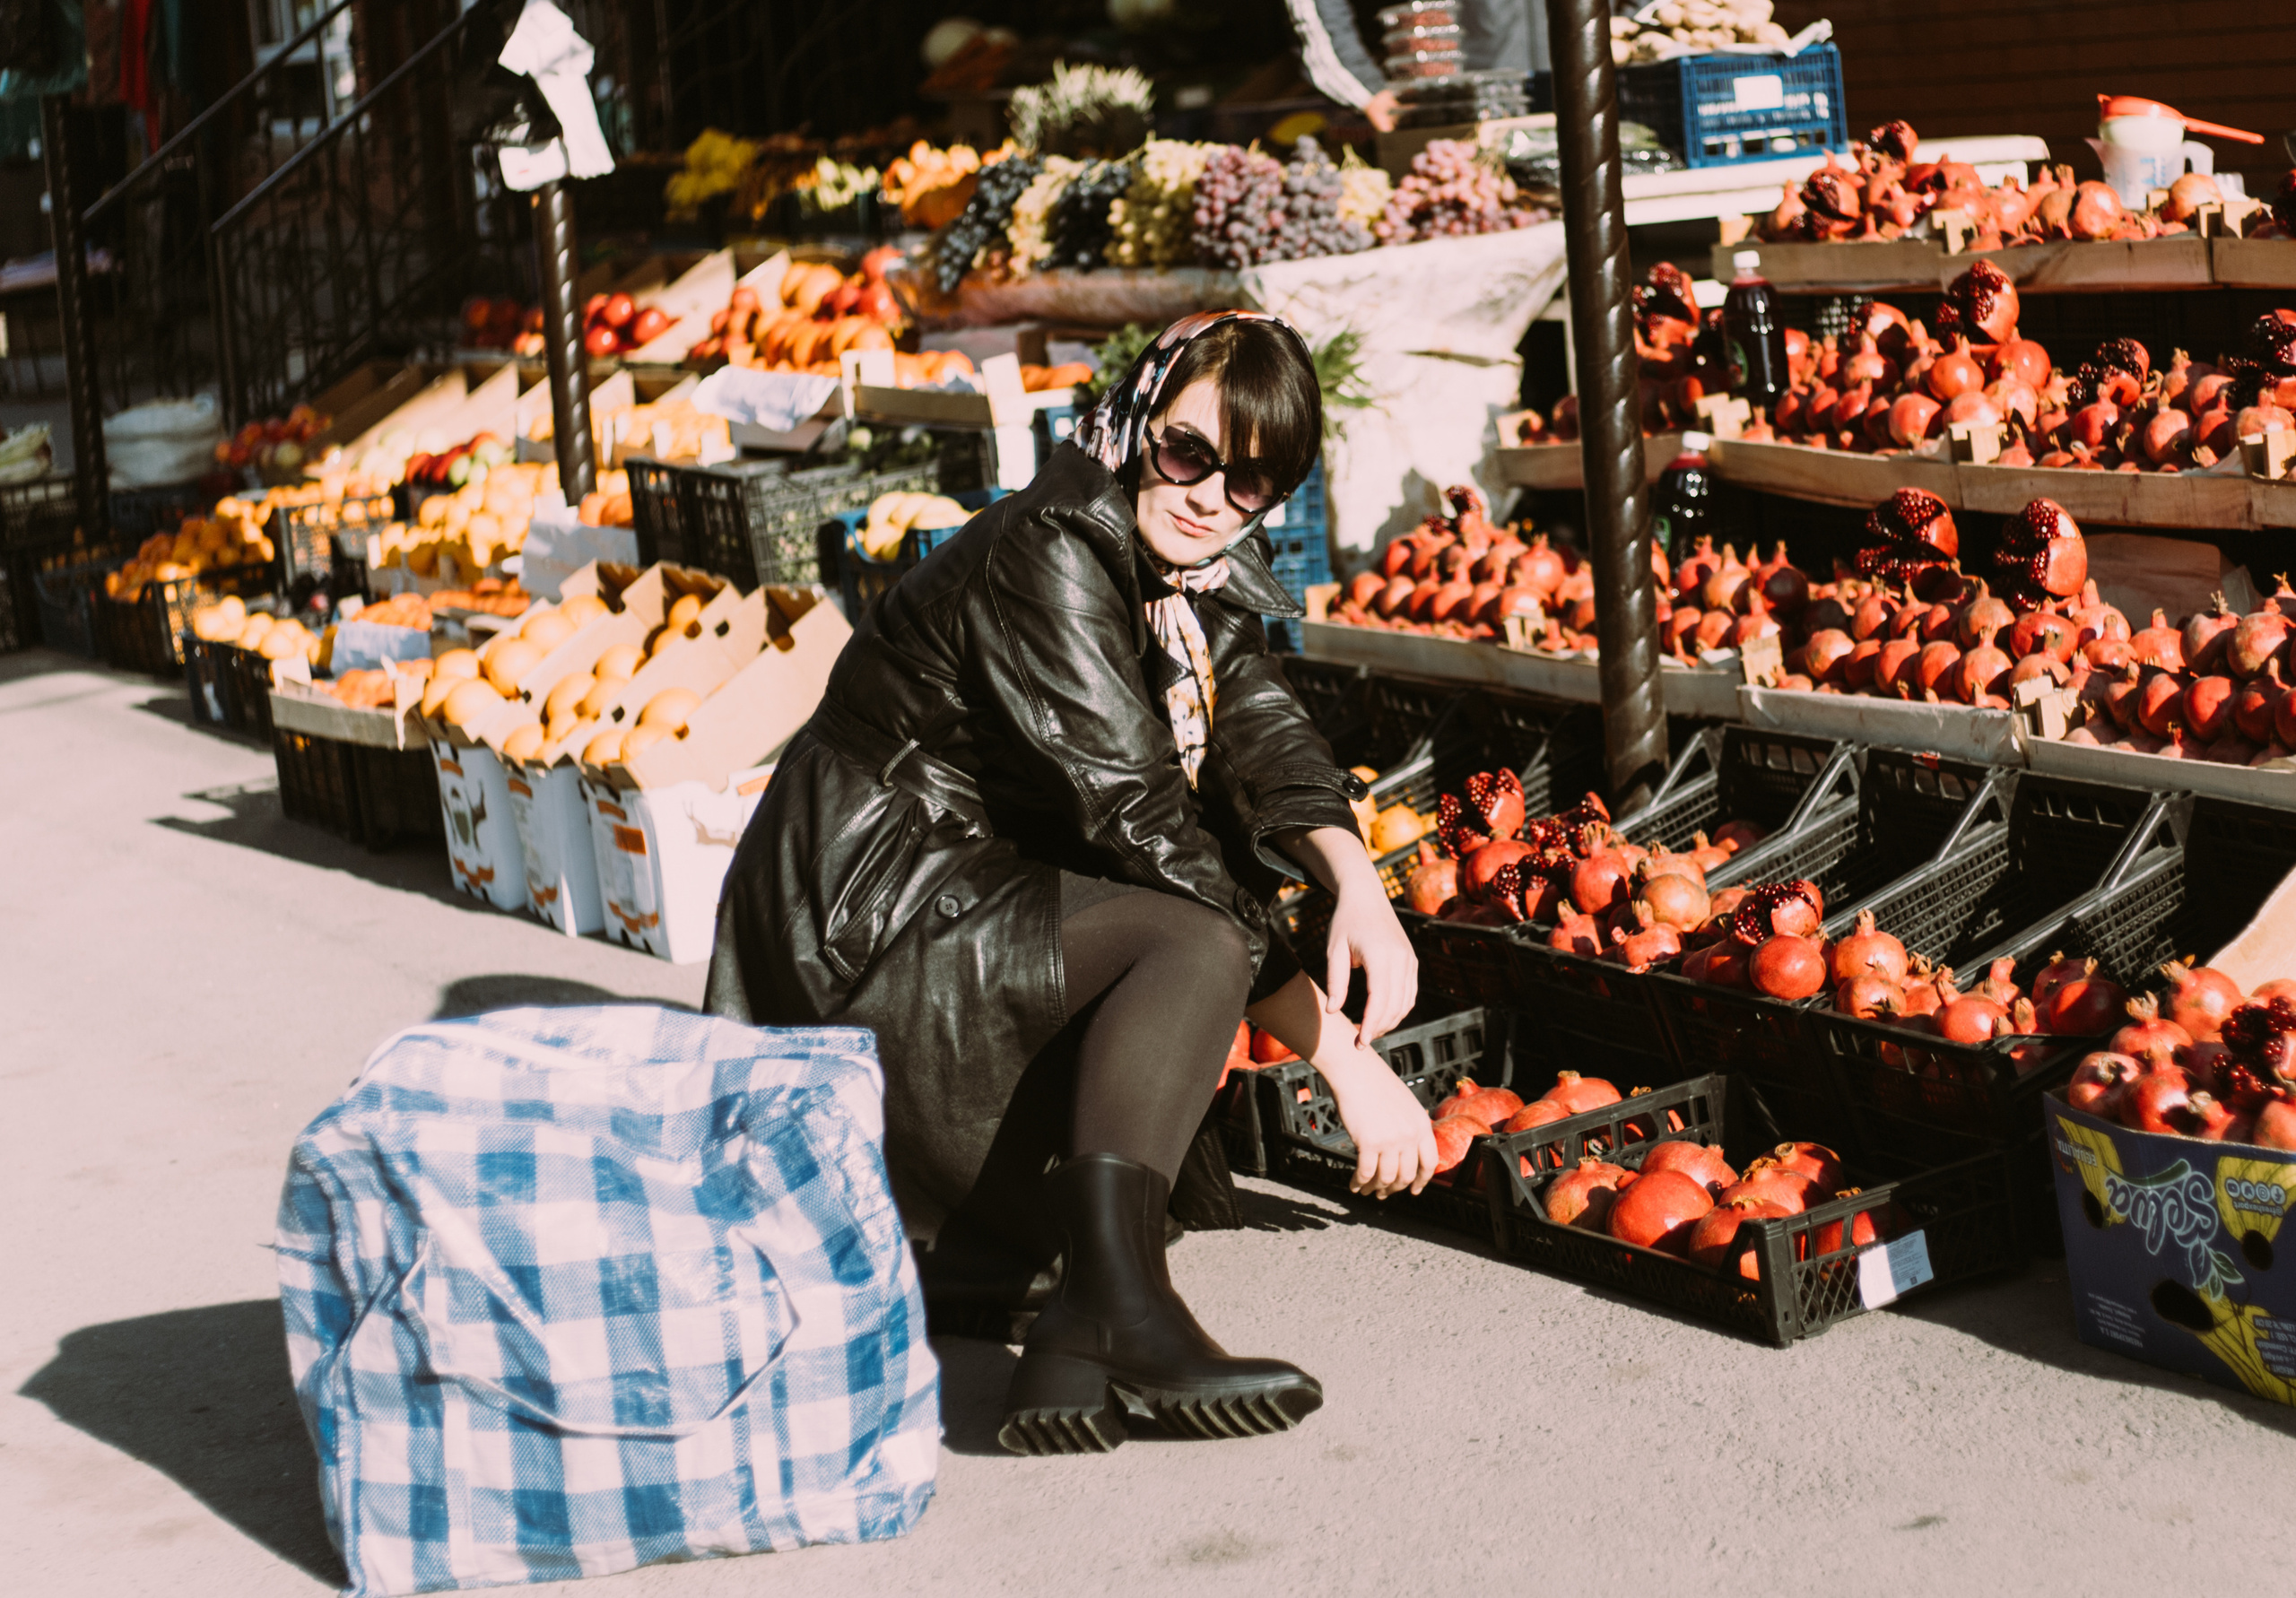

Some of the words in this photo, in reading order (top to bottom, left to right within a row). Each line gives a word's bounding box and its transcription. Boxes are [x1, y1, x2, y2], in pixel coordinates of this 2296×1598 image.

[2105, 1171, 2218, 1255] Selva
[2233, 1200, 2283, 1216] @freshexport
[2255, 1317, 2265, 1327] CM
[2256, 1340, 2287, 1353] Cavendish
